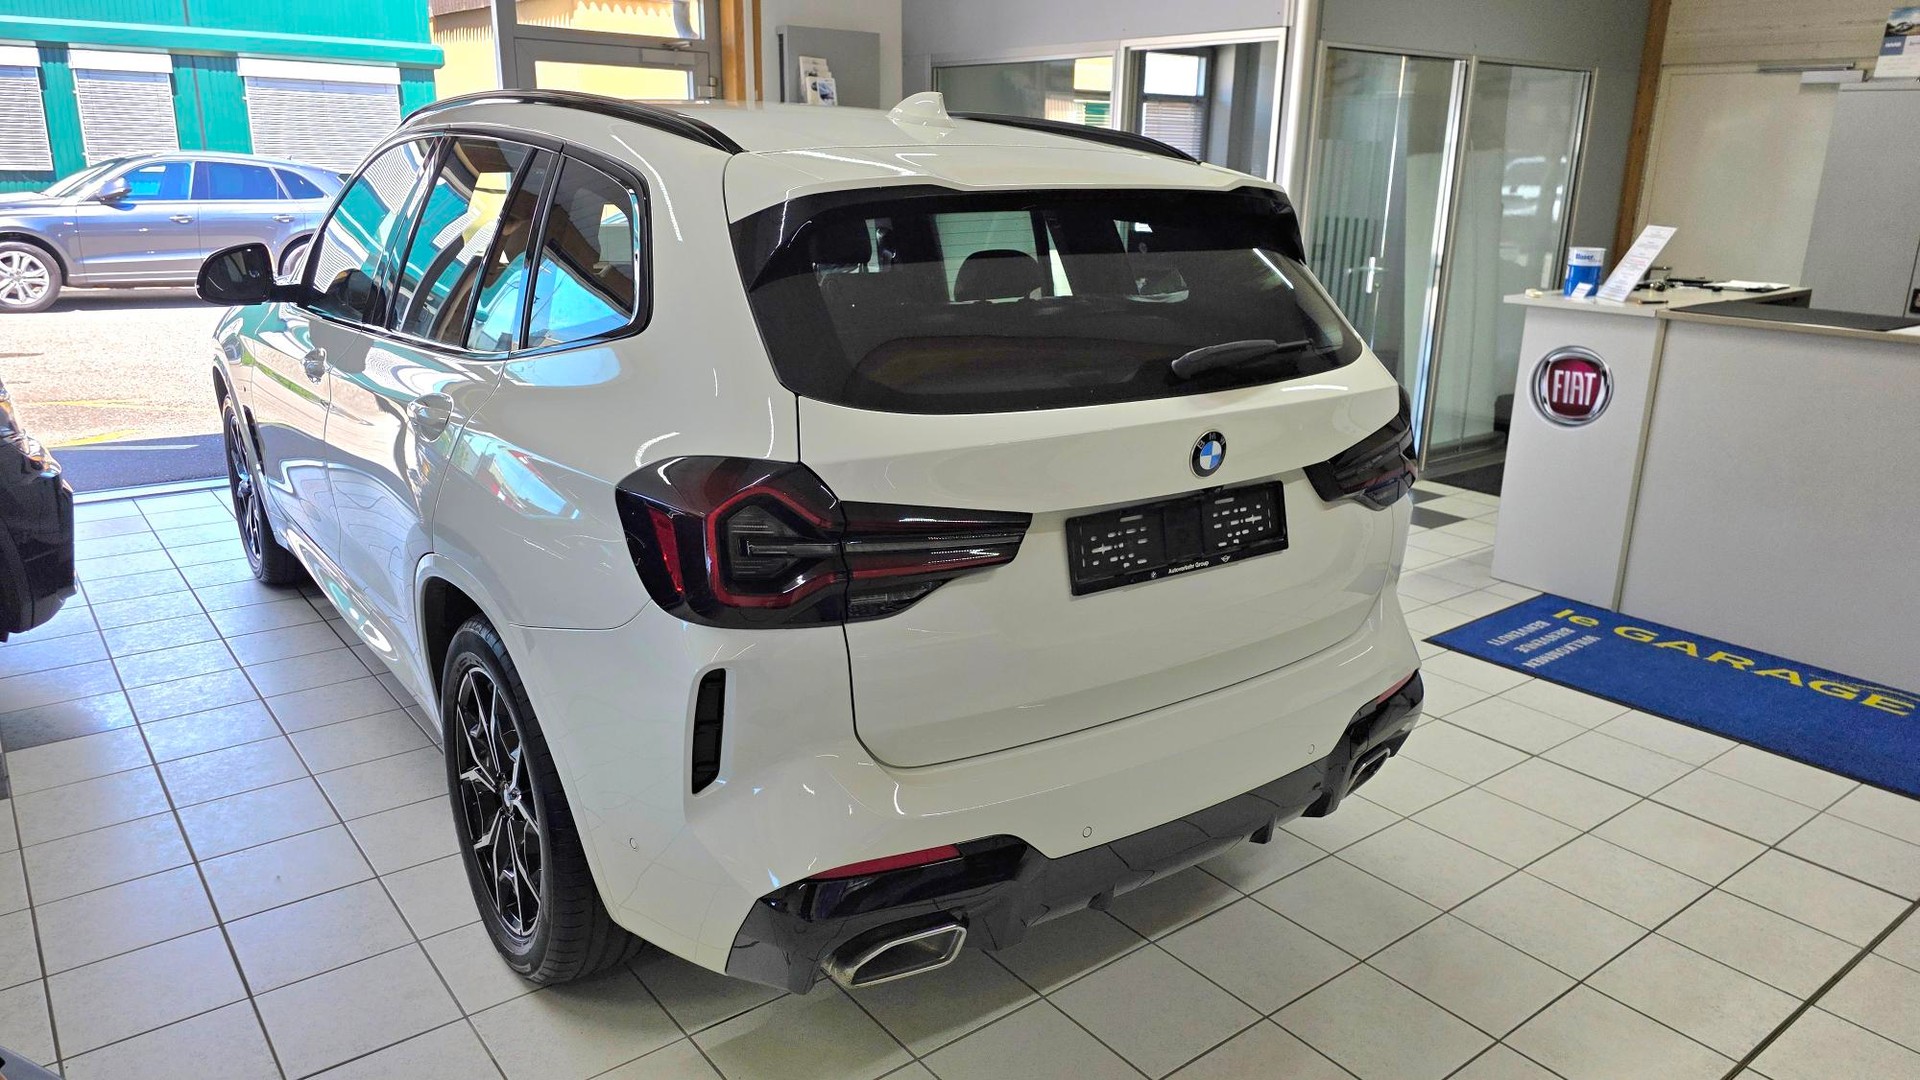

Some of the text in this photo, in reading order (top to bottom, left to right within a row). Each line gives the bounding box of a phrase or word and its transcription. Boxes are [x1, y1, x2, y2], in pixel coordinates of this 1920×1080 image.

[1552, 369, 1597, 406] FIAT
[1196, 432, 1226, 450] BMW
[1195, 560, 1209, 568] Group
[1613, 626, 1915, 716] GARAGE
